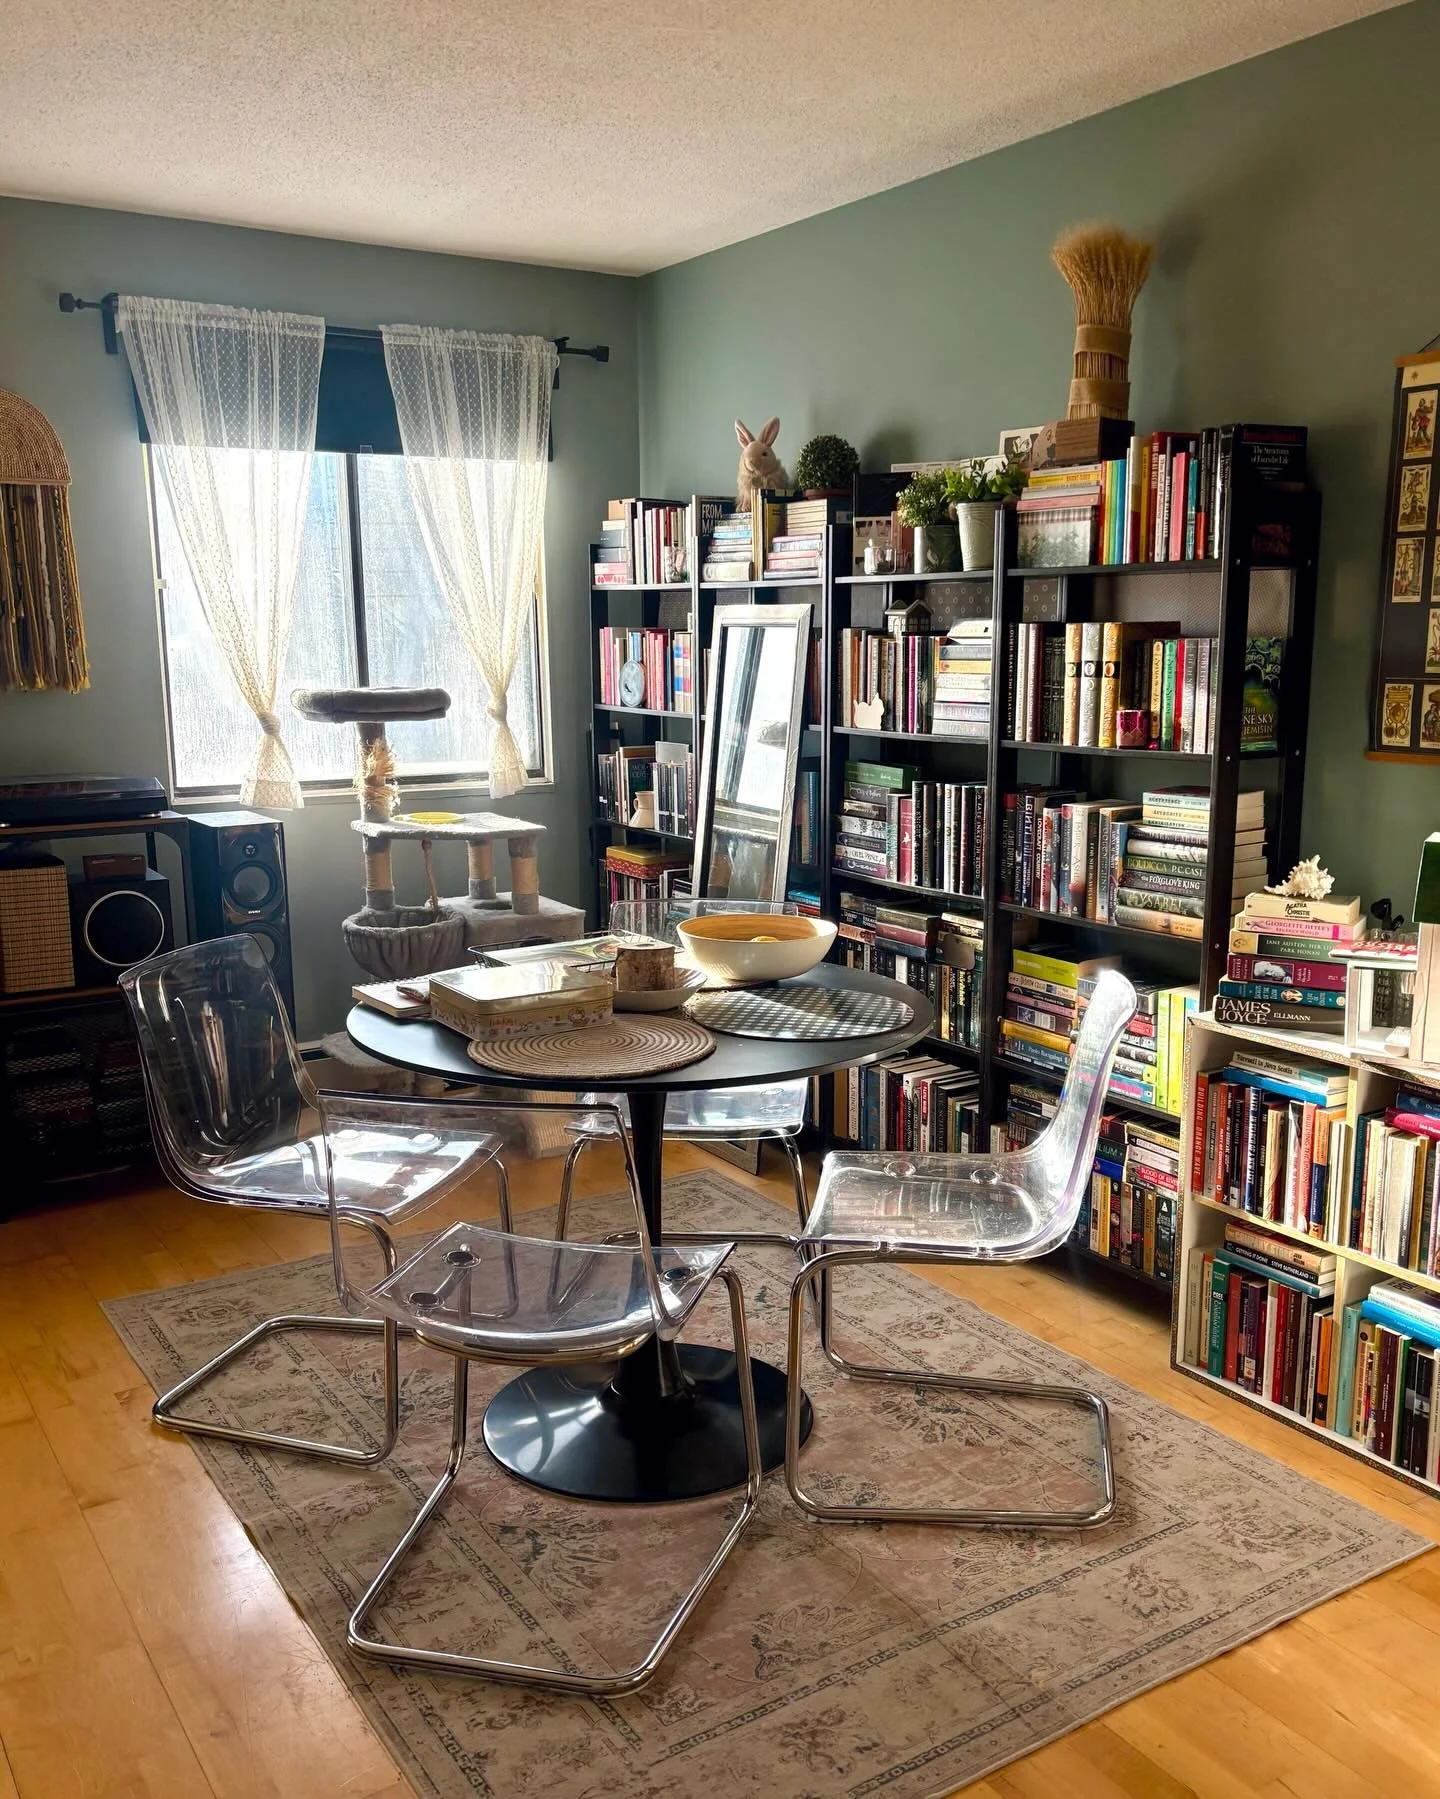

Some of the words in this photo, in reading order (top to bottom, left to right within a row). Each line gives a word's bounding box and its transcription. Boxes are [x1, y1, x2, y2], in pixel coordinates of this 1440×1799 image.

[702, 504, 723, 519] FROM
[1257, 713, 1273, 724] SKY
[1014, 866, 1022, 893] Kindred
[1149, 875, 1182, 888] FOXGLOVE
[1182, 880, 1200, 890] KING
[1285, 903, 1307, 912] AGATHA
[1287, 908, 1310, 916] CHRISTIE
[1219, 998, 1271, 1014] JAMES
[1219, 1008, 1268, 1025] JOYCE
[1273, 1012, 1311, 1022] ELLMANN
[1277, 1064, 1293, 1075] Scotia
[1196, 1087, 1205, 1120] BUILDING
[1195, 1126, 1204, 1154] ORANGE
[1098, 1144, 1118, 1157] LIUM
[1303, 1147, 1311, 1160] THE
[1141, 1167, 1157, 1178] BLOOD
[1193, 1157, 1202, 1175] WAVE
[1235, 1247, 1252, 1258] GETTING
[1256, 1255, 1269, 1263] DONE
[1271, 1260, 1283, 1269] STEVE
[1283, 1265, 1309, 1279] SUTHERLAND
